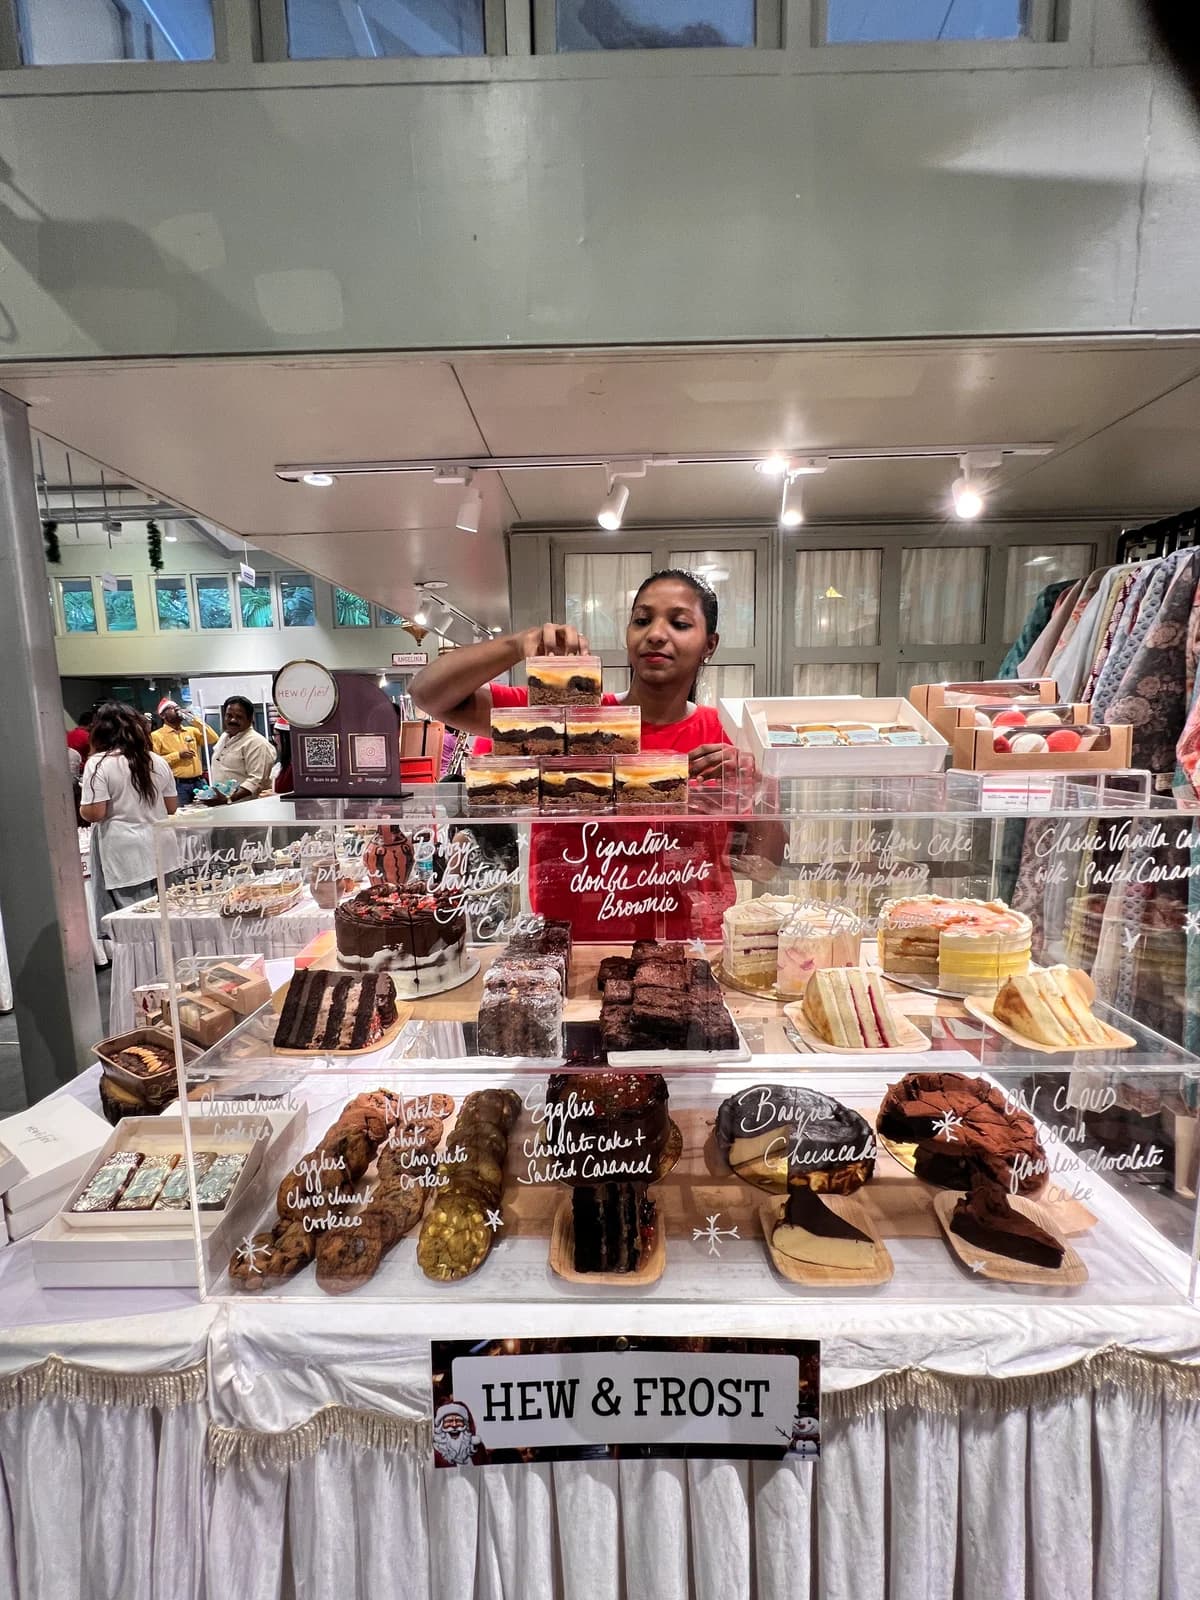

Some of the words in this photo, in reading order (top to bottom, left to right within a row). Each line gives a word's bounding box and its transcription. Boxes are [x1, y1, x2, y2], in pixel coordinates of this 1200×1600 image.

[279, 690, 298, 698] HEW
[562, 821, 681, 875] Signature
[1035, 822, 1107, 857] Classic
[1109, 820, 1169, 852] Vanilla
[570, 865, 636, 893] double
[636, 859, 713, 887] chocolate
[1034, 861, 1068, 884] with
[1076, 861, 1137, 888] Salted
[597, 891, 678, 921] Brownie
[524, 1084, 595, 1140] Eggless
[738, 1086, 835, 1135] Basque
[1005, 1086, 1042, 1115] ON
[1054, 1086, 1117, 1113] CLOUD
[764, 1133, 878, 1168] Cheesecake
[1035, 1121, 1086, 1146] COCOA
[517, 1159, 577, 1184] Salted
[581, 1154, 653, 1178] Caramel
[481, 1378, 581, 1422] HEW
[590, 1377, 622, 1417] &
[632, 1377, 771, 1418] FROST
